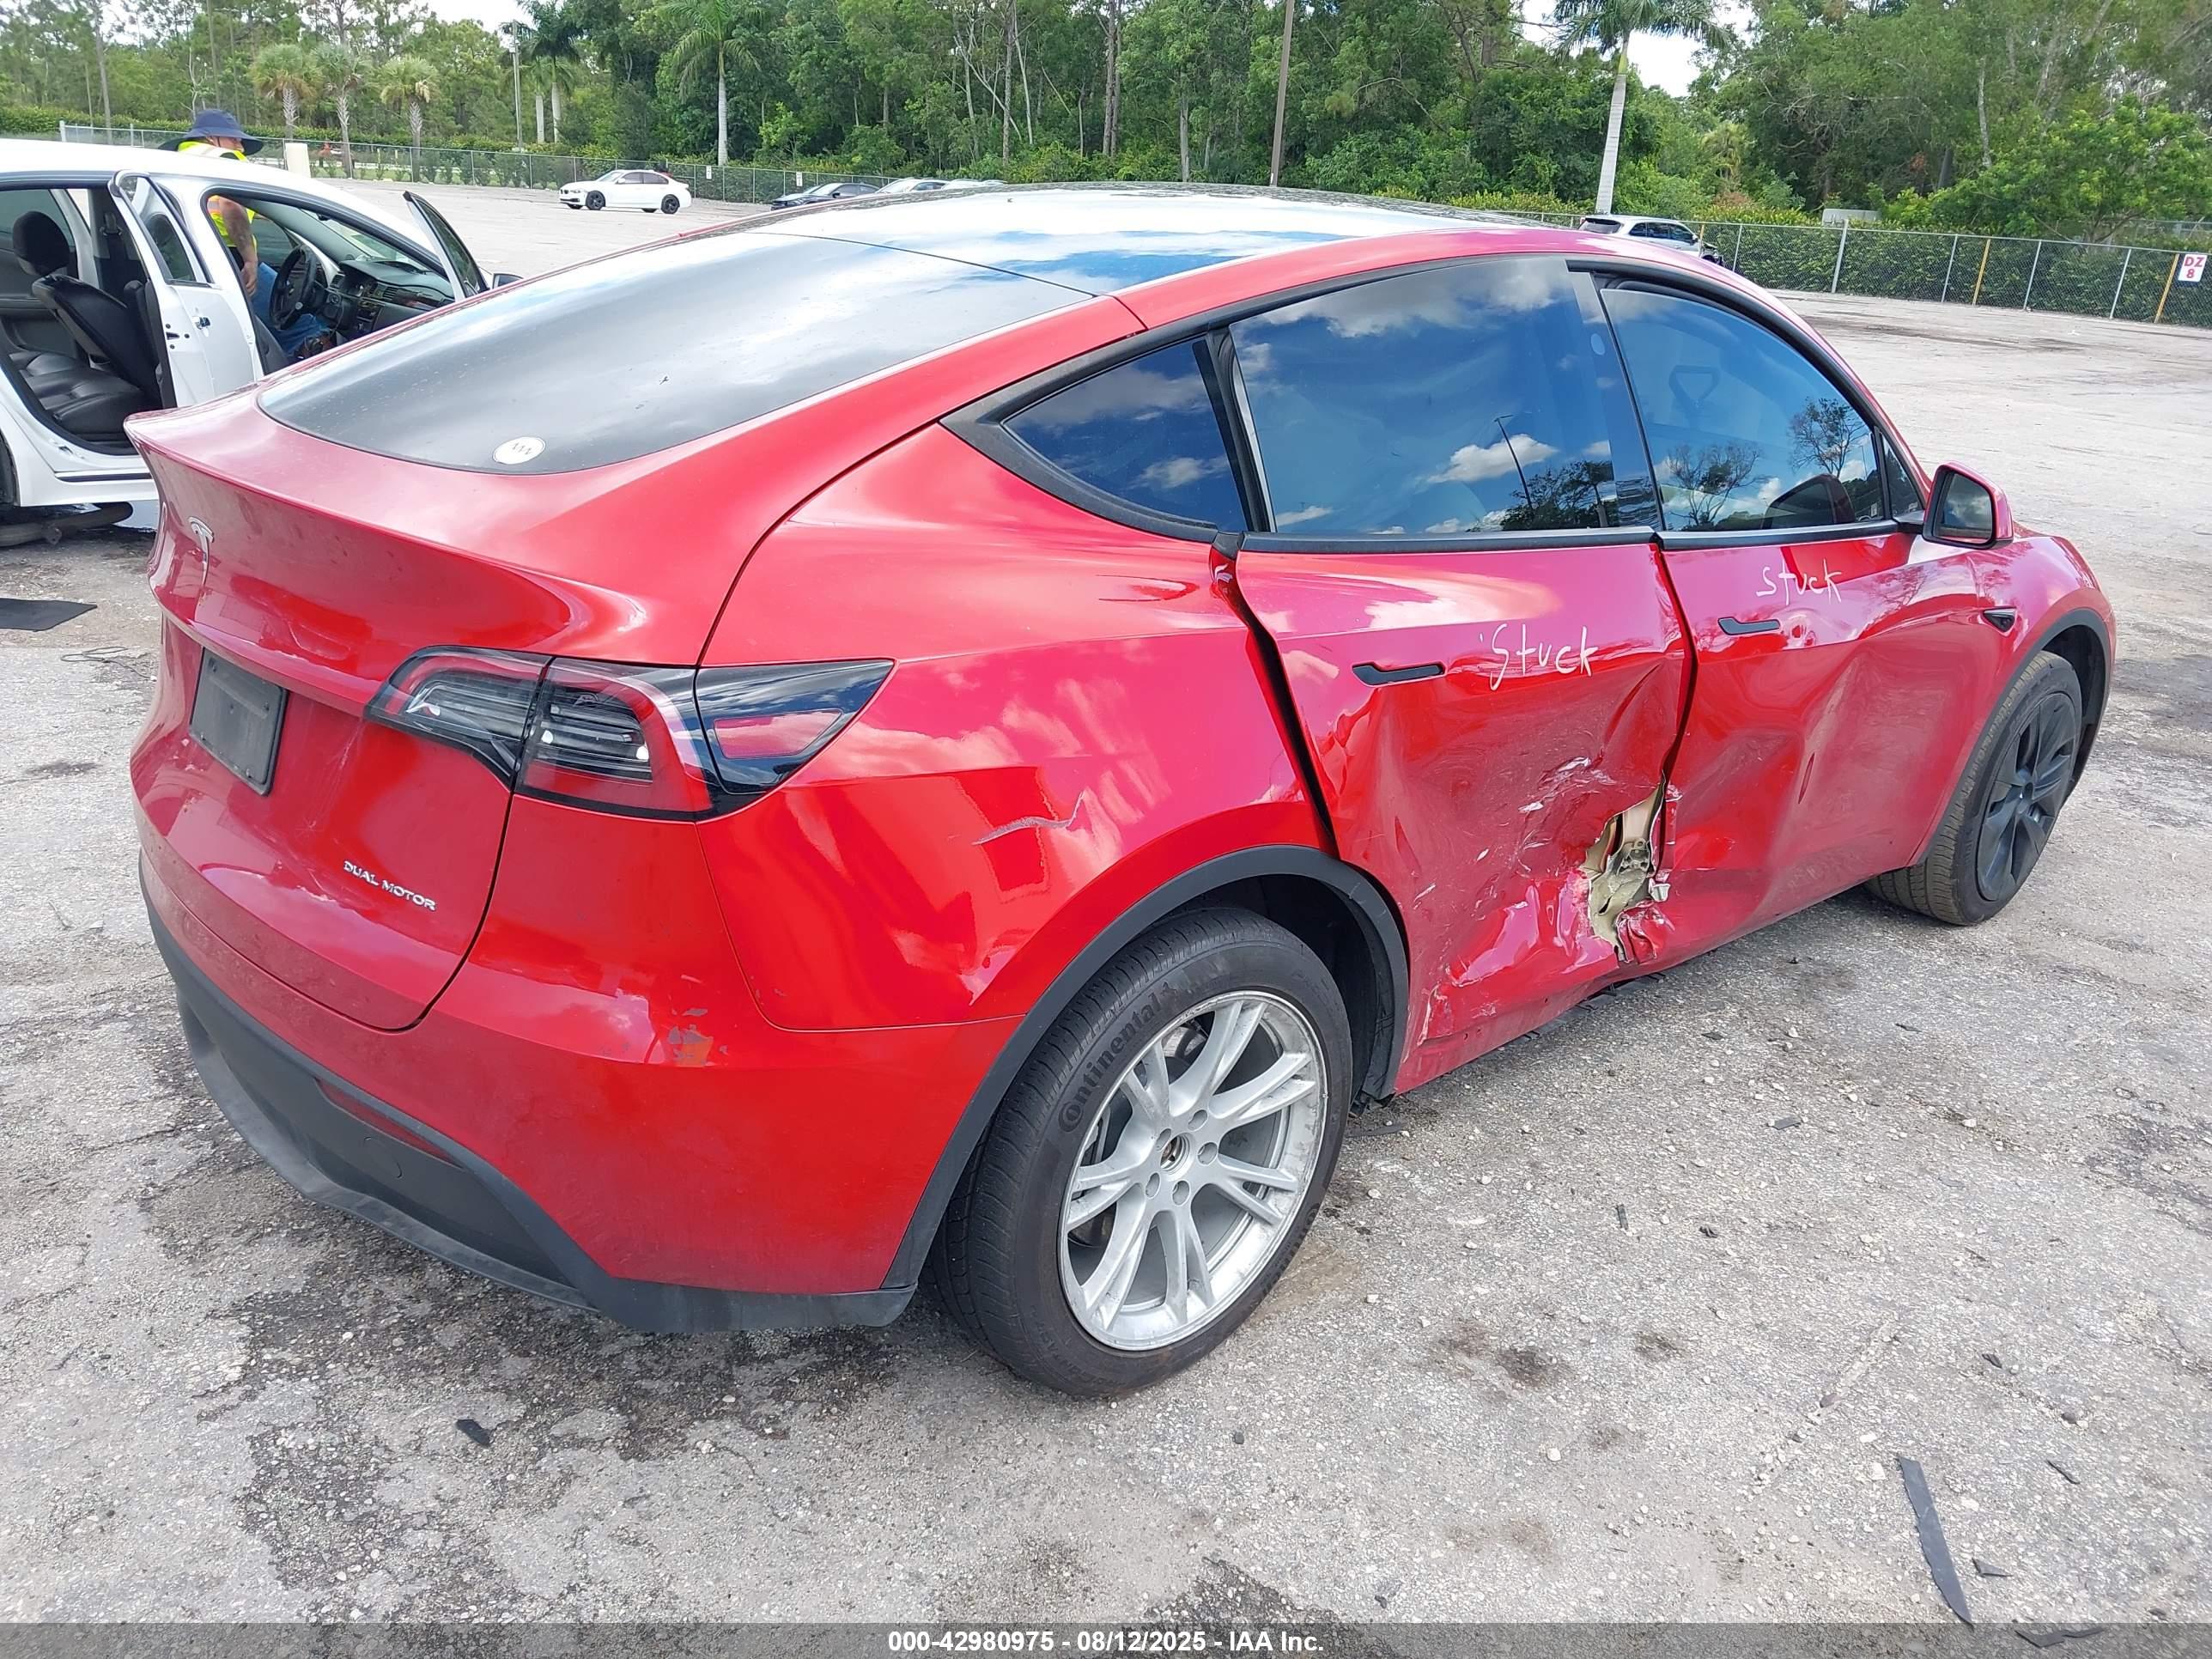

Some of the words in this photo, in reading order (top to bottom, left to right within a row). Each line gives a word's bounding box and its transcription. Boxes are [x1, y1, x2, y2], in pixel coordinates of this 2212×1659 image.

[2184, 256, 2205, 268] DZ
[2186, 268, 2195, 279] 8
[1489, 623, 1599, 691] Stuck
[343, 860, 380, 886] DUAL
[381, 879, 436, 911] MOTOR
[1058, 993, 1159, 1133] Continental
